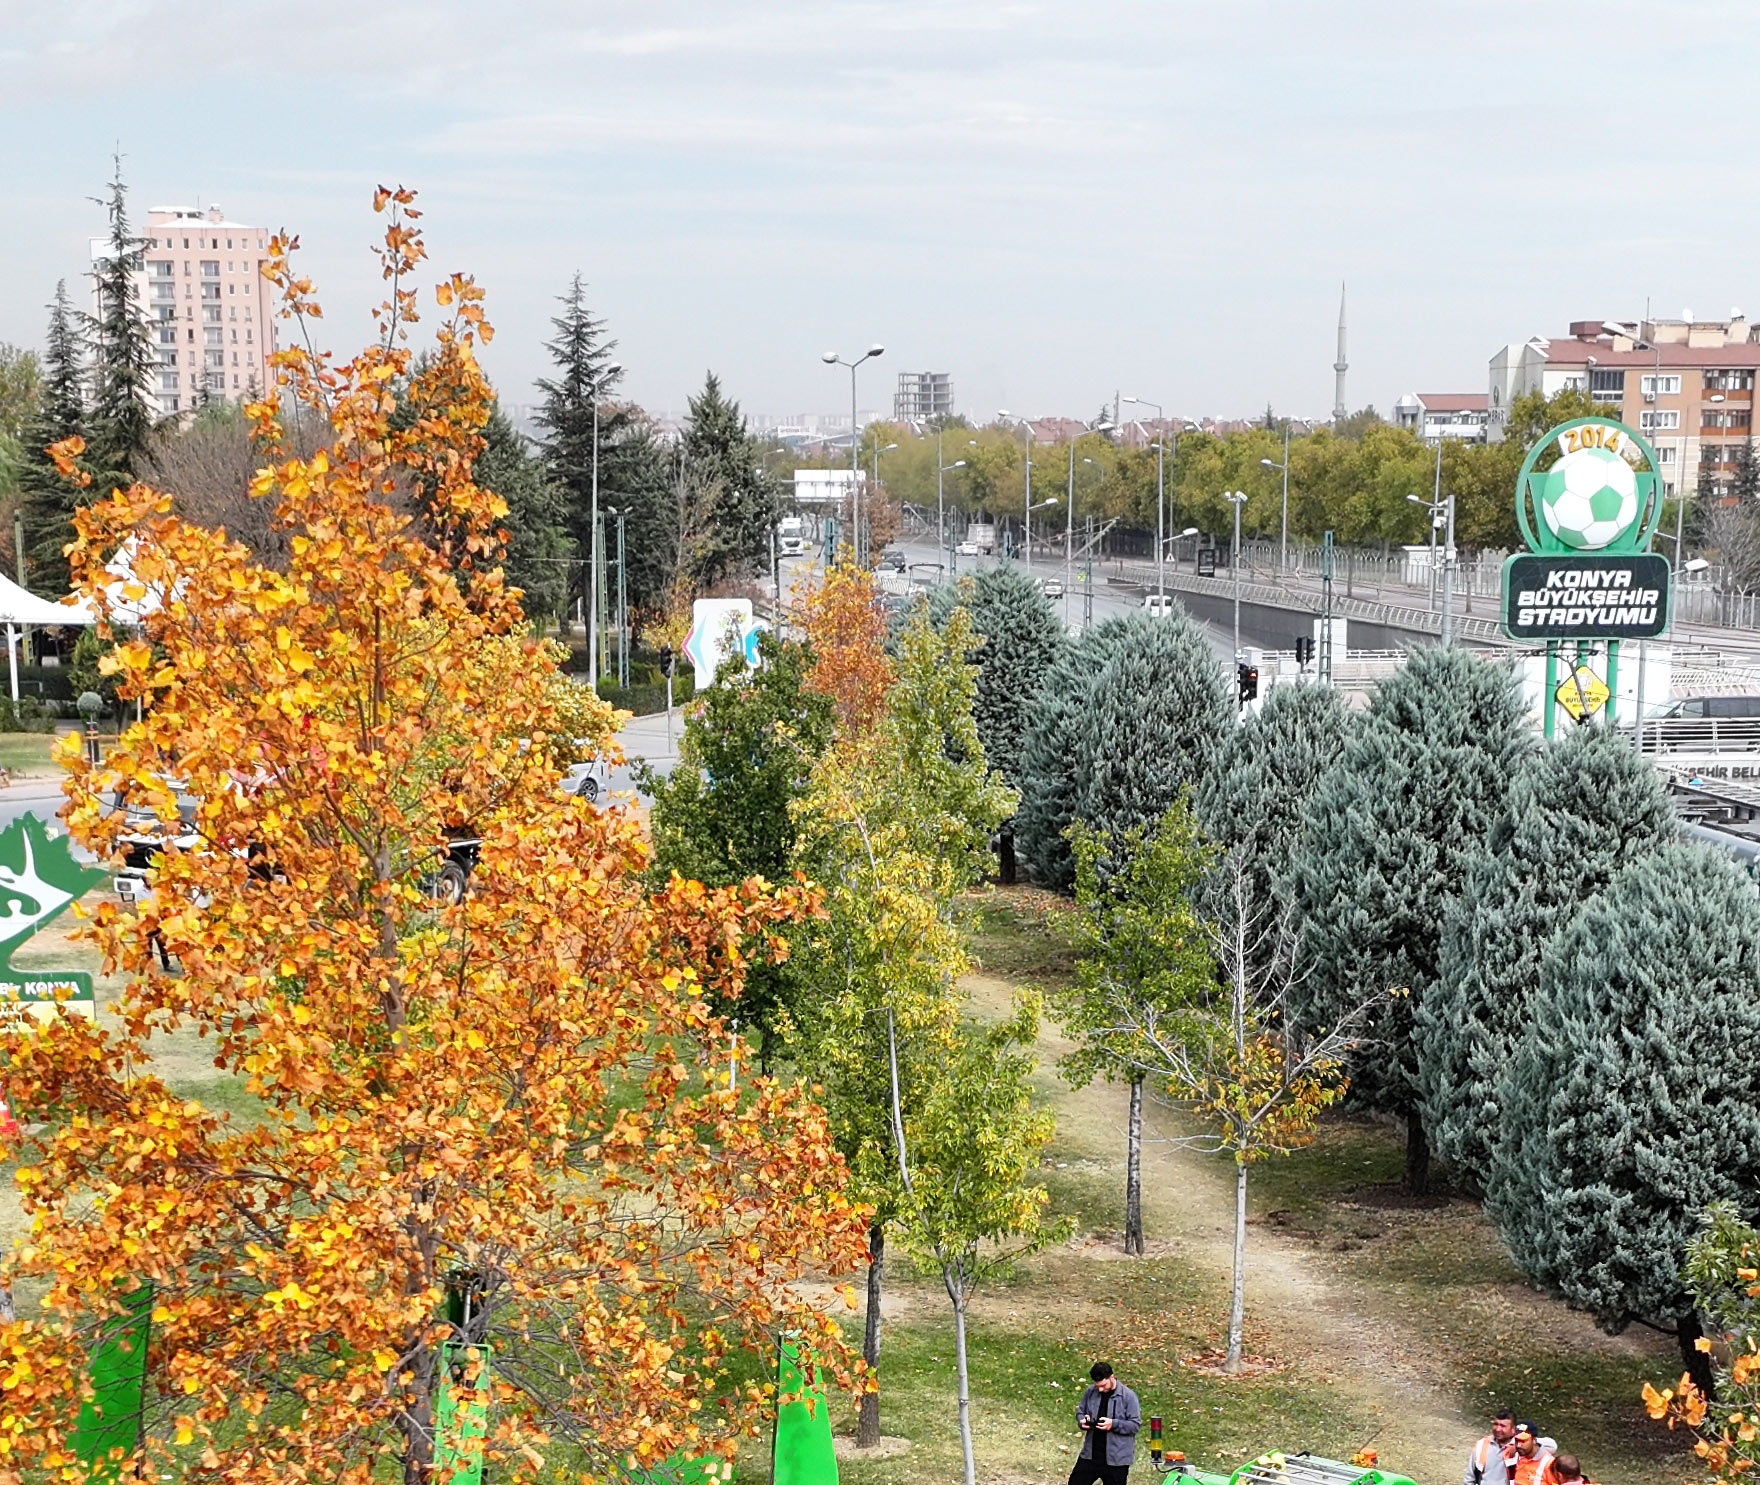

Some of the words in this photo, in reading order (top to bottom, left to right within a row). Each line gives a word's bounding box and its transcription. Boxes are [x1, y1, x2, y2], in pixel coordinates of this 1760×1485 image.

[1565, 425, 1620, 453] 2014
[1546, 570, 1632, 588] KONYA
[1517, 587, 1659, 607] BÜYÜKŞEHİR
[1517, 607, 1658, 626] STADYUMU
